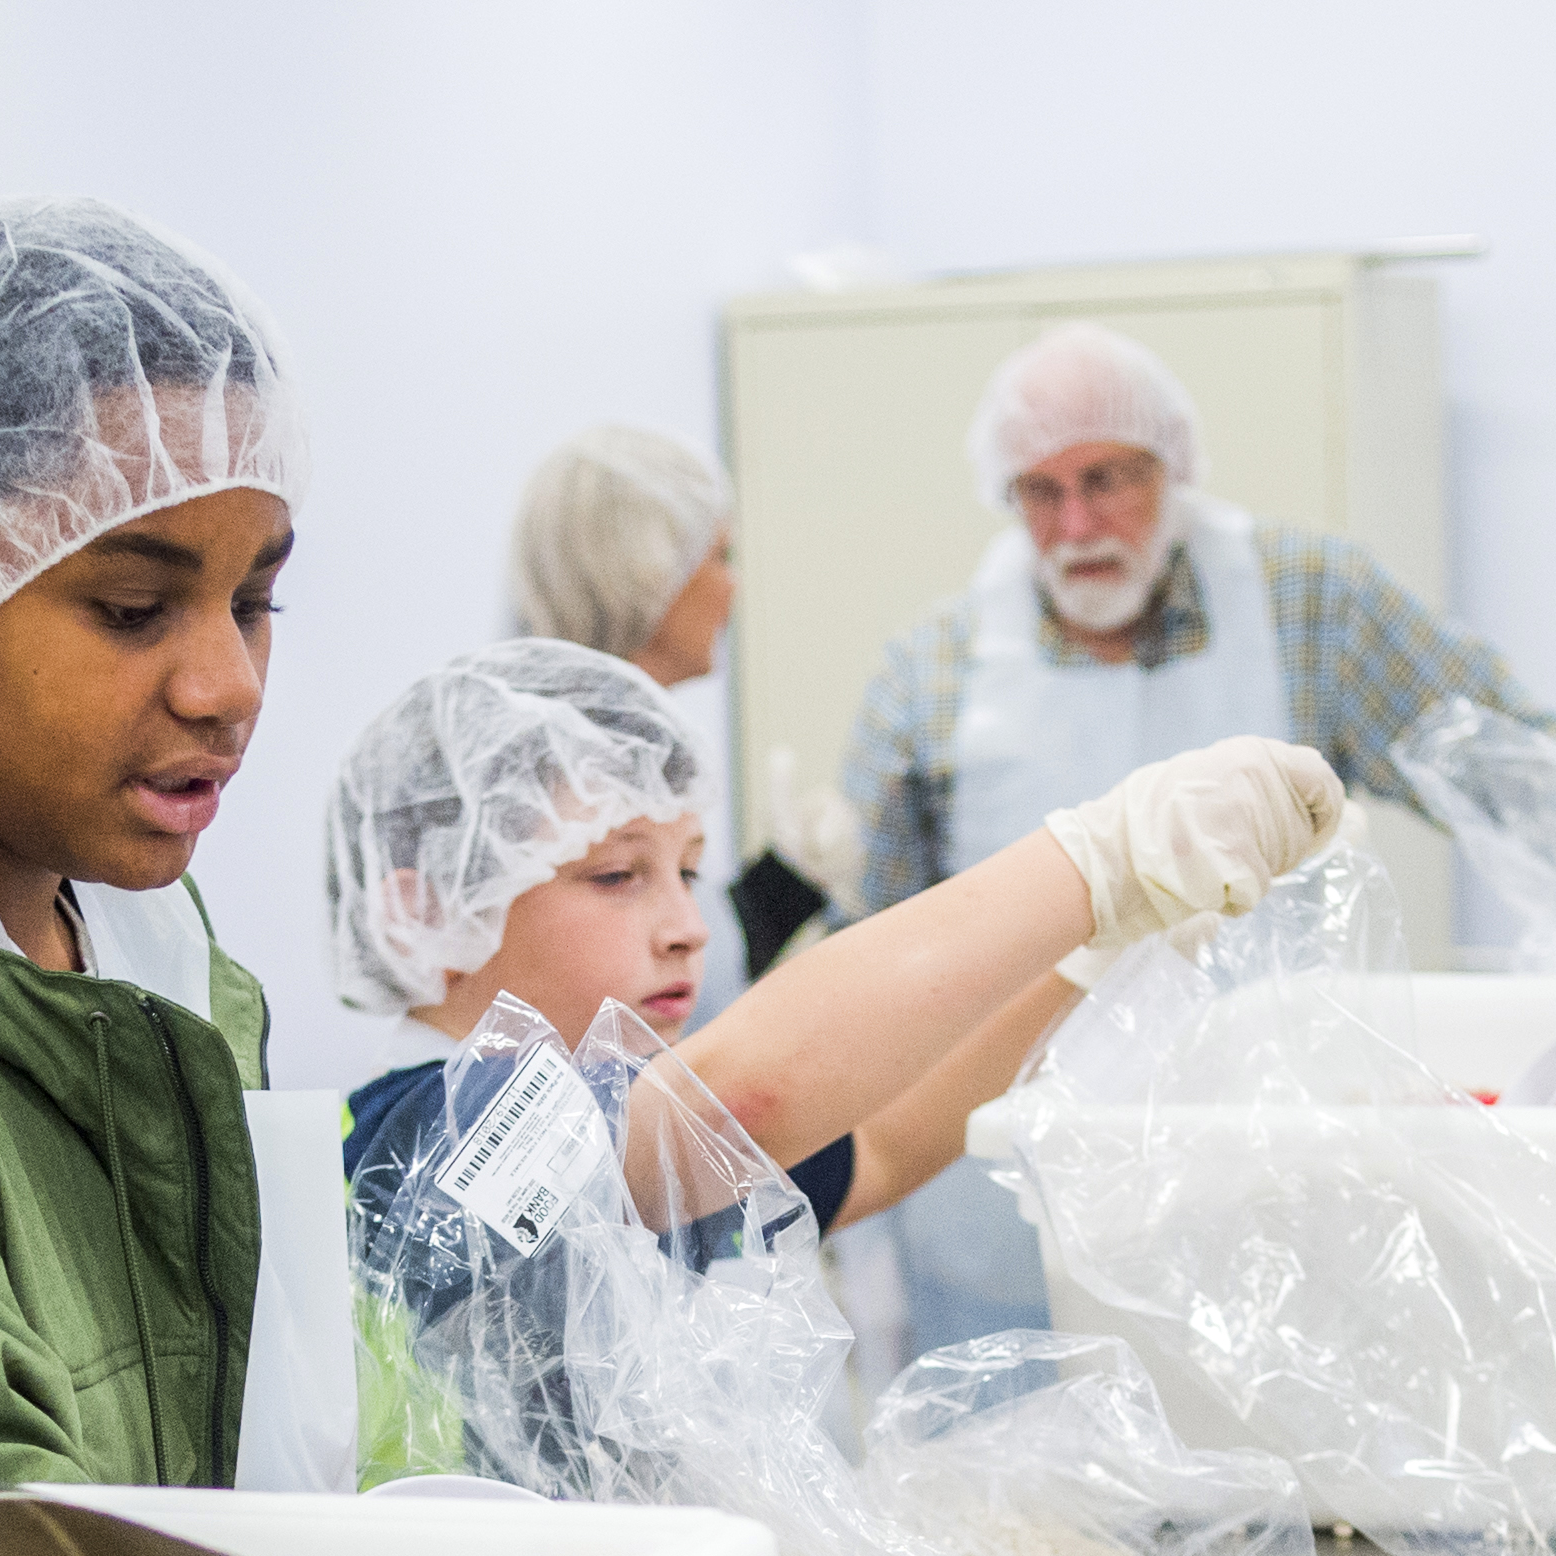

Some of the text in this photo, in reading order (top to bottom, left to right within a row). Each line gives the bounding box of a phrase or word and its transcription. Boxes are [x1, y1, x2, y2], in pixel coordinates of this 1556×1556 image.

[470, 1084, 522, 1146] 11/19/2018
[533, 1091, 549, 1110] date:
[521, 1185, 550, 1217] BANK
[531, 1192, 560, 1225] FOOD
